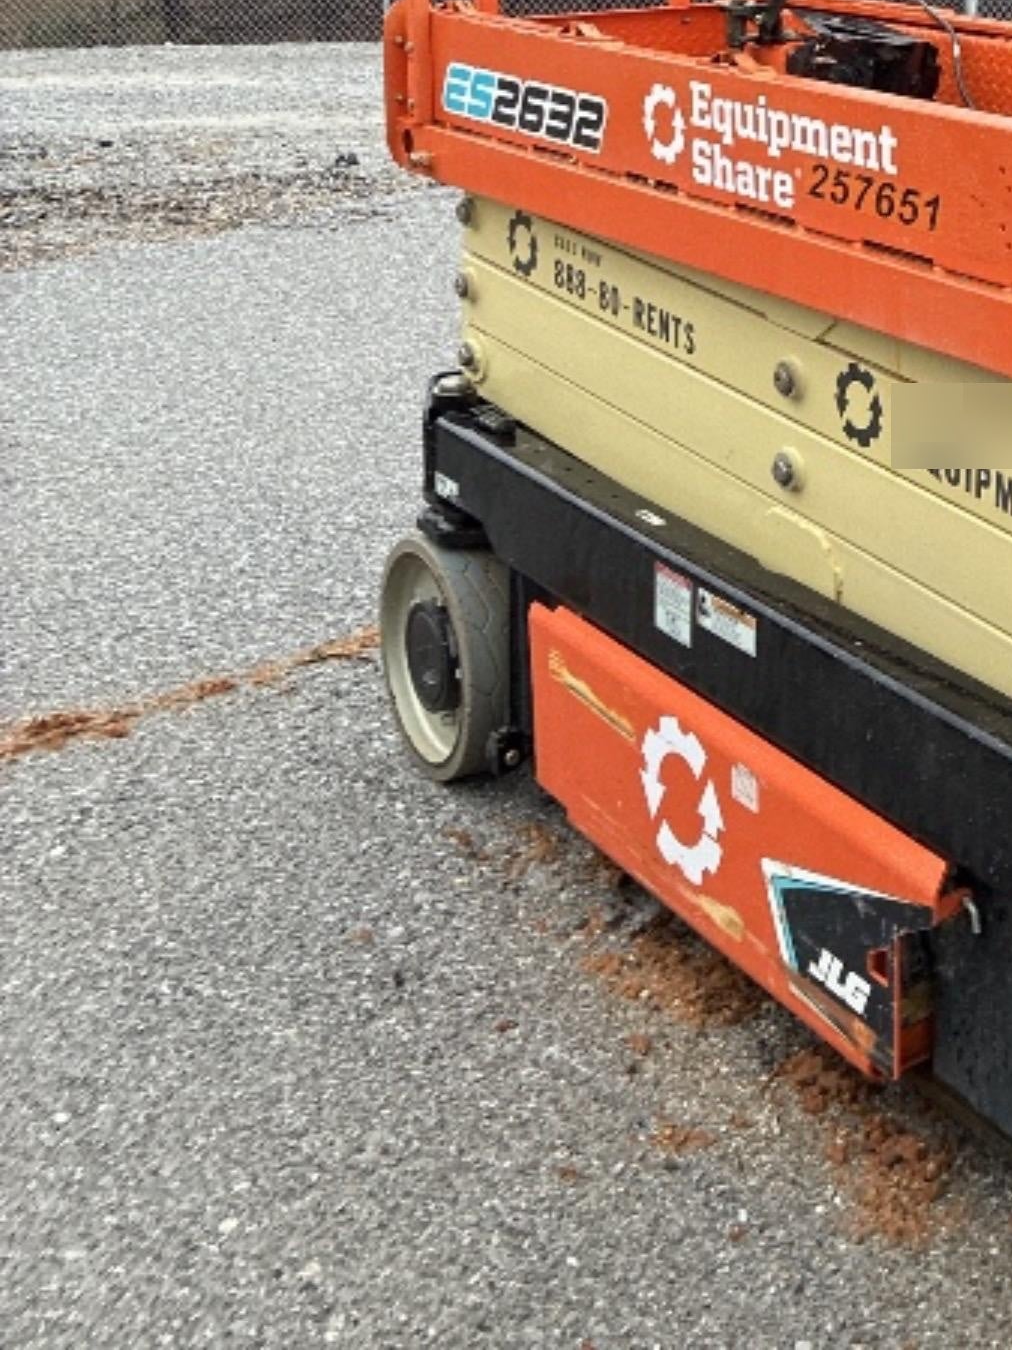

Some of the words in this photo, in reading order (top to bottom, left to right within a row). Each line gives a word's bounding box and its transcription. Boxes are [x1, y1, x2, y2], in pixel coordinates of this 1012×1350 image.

[442, 62, 607, 153] ES2632
[688, 80, 898, 175] Equipment
[692, 140, 796, 209] Share
[808, 164, 942, 232] 257651
[807, 947, 871, 1016] JLG
